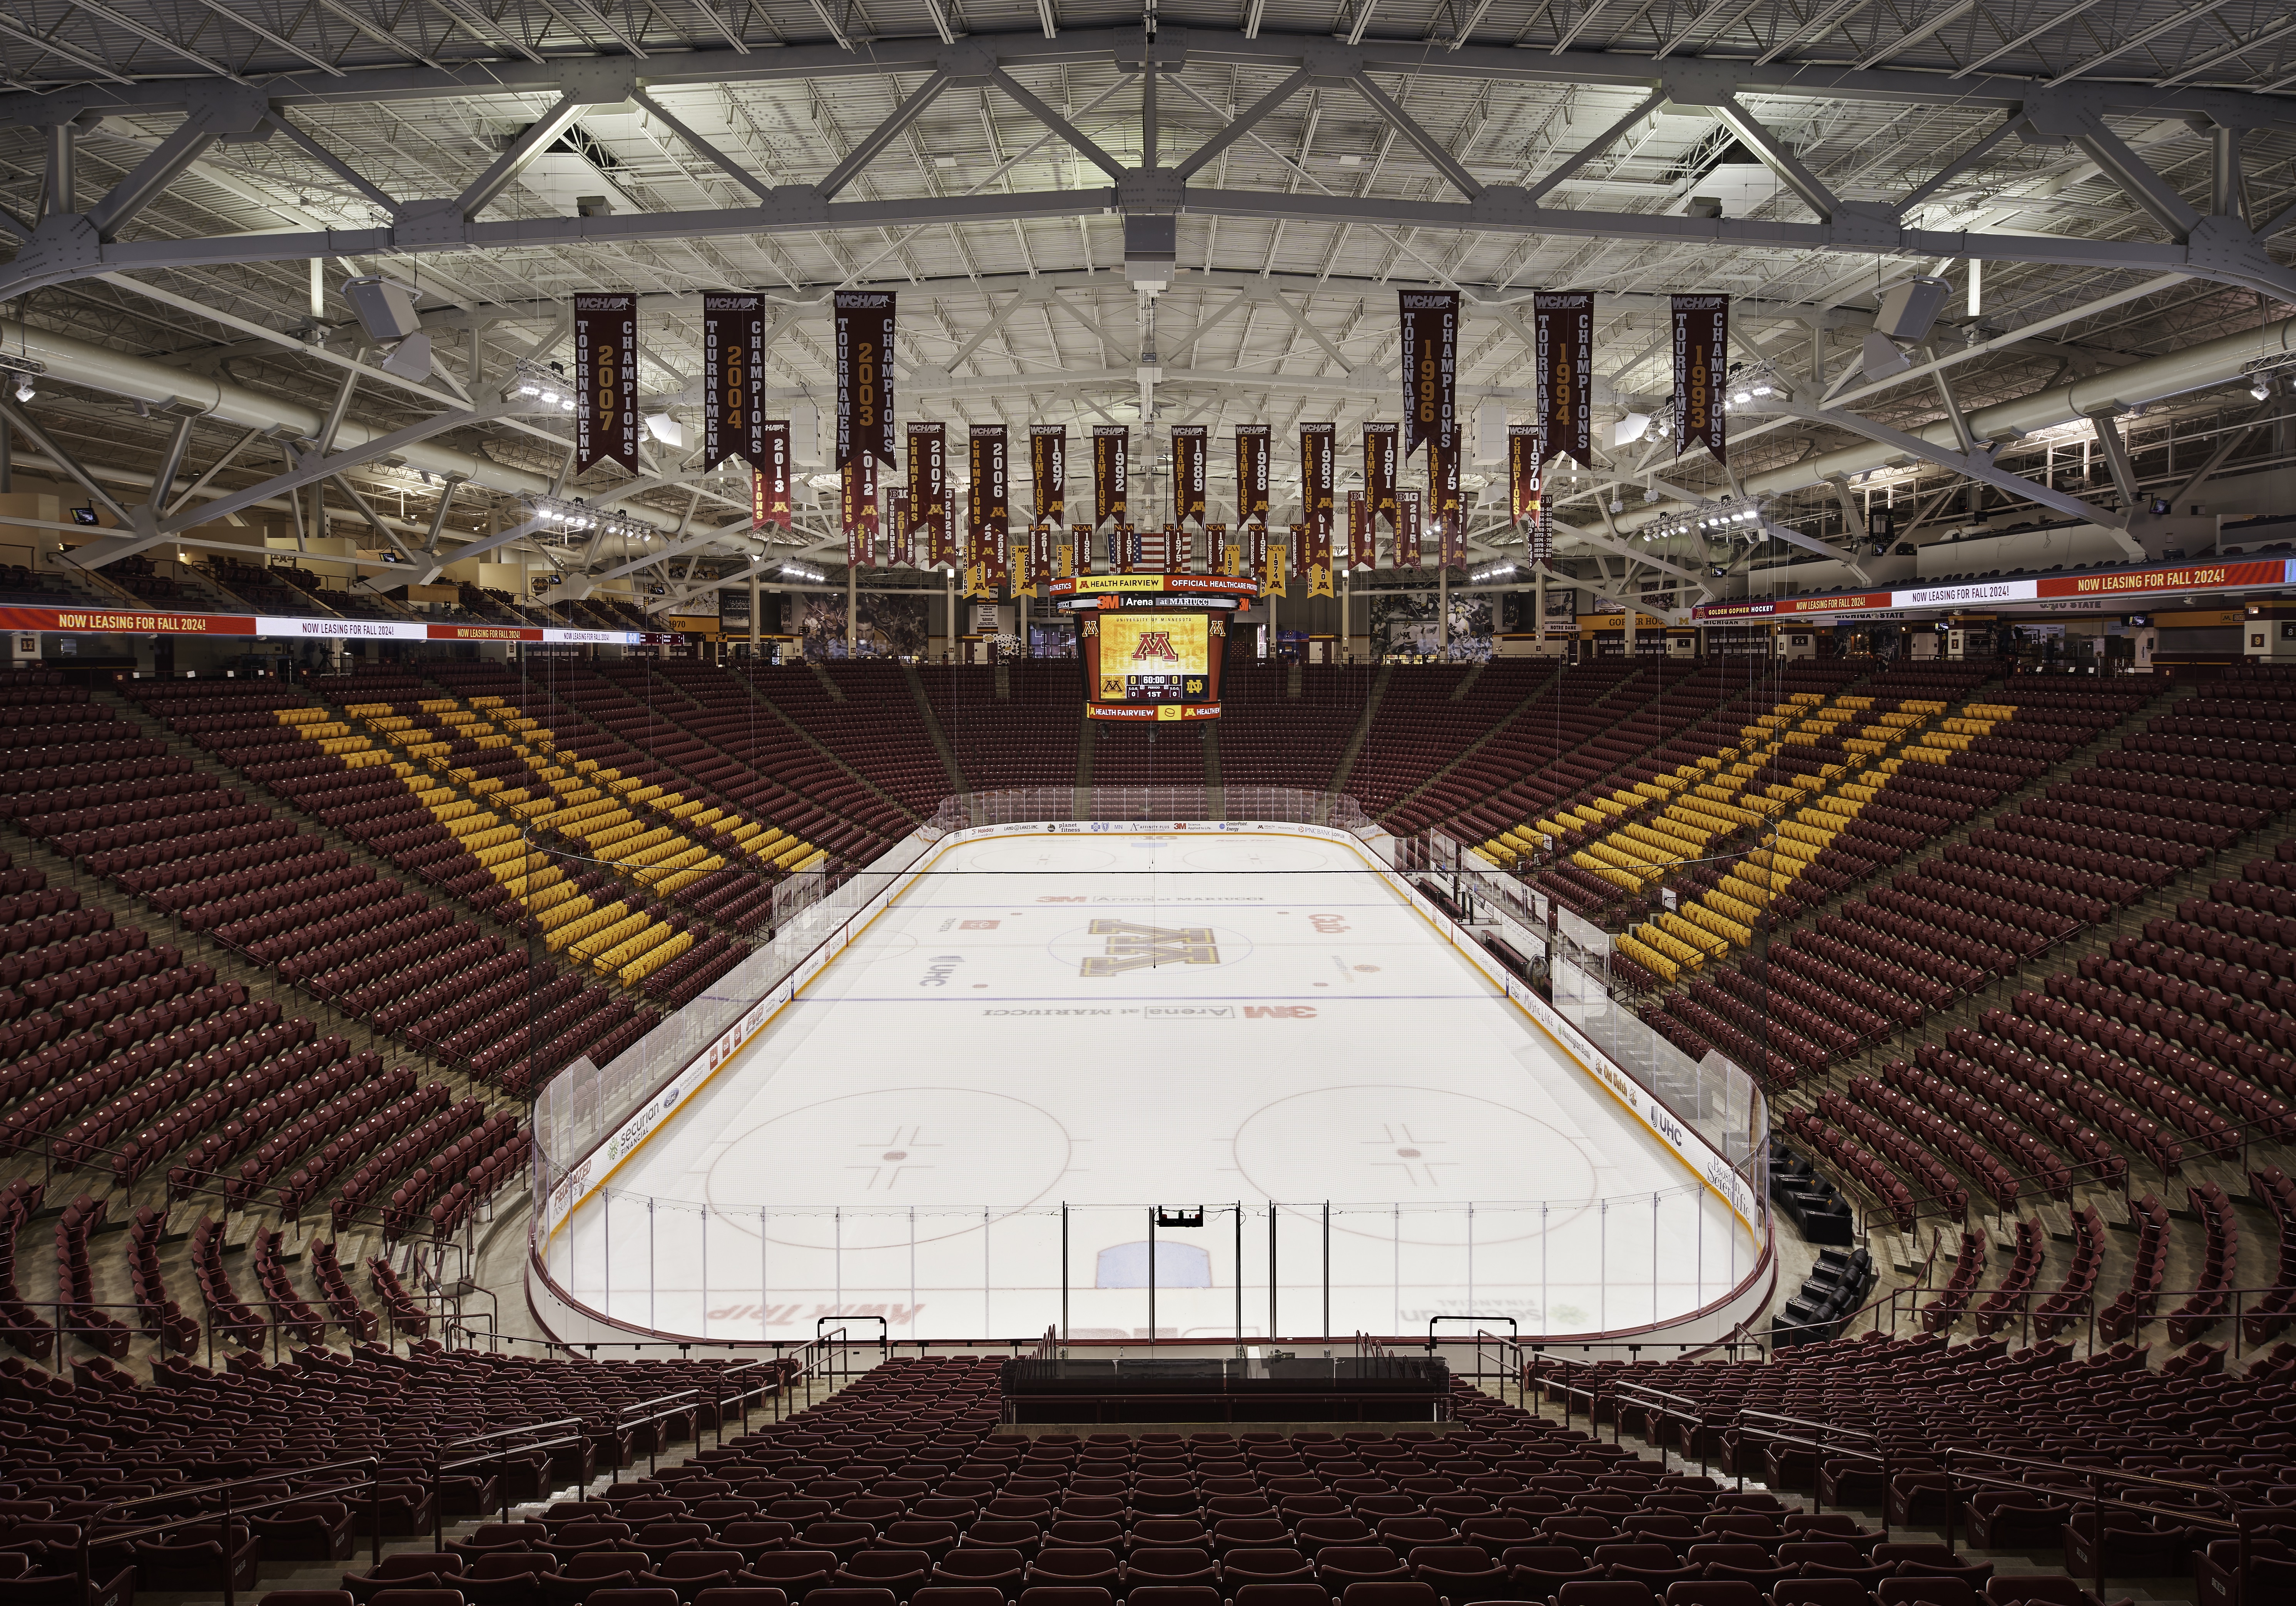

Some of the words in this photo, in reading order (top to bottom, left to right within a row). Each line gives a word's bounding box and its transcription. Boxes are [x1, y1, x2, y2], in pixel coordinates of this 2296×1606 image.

[577, 298, 621, 308] WCHA
[707, 298, 750, 308] WCHA
[836, 295, 879, 306] WCHA
[1404, 296, 1444, 307] WCHA
[1536, 296, 1579, 307] WCHA
[1672, 298, 1715, 308] WCHA
[578, 321, 590, 461] TOURNAMENT
[598, 345, 613, 430] 2007
[622, 321, 634, 455] CHAMPIONS
[707, 321, 719, 459] TOURNAMENT
[728, 346, 742, 428] 2004
[750, 321, 762, 453] CHAMPIONS
[838, 318, 850, 457] TOURNAMENT
[859, 343, 873, 426] 2003
[882, 319, 894, 452] CHAMPIONS
[1404, 313, 1415, 452] TOURNAMENT
[1421, 340, 1435, 422] 1996
[1441, 314, 1453, 447] CHAMPIONS
[1538, 315, 1549, 453] TOURNAMENT
[1556, 343, 1570, 425] 1994
[1577, 315, 1589, 448] CHAMPIONS
[1675, 313, 1687, 452] TOURNAMENT
[1691, 345, 1706, 428] 1993
[1711, 313, 1723, 447] CHAMPIONS
[774, 438, 784, 492] 2013
[931, 440, 940, 495] 2007
[973, 440, 981, 524] CHAMPIONS
[993, 443, 1003, 497] 2006
[1035, 437, 1043, 515] CHAMPIONS
[1053, 439, 1062, 491] 1997
[1115, 440, 1125, 492] 1992
[1176, 438, 1185, 515] CHAMPIONS
[1194, 440, 1203, 491] 1989
[1257, 439, 1266, 490] 1988
[1305, 435, 1313, 513] CHAMPIONS
[1322, 437, 1331, 489] 1983
[1367, 435, 1375, 512] CHAMPIONS
[1384, 437, 1394, 488] 1981
[1513, 437, 1521, 515] CHAMPIONS
[1530, 439, 1539, 491] 1970
[1031, 567, 1035, 577] UP
[1052, 583, 1071, 591] ATHLETICS
[1210, 581, 1246, 589] HEALTHCARE
[1293, 568, 1297, 577] UP
[1912, 592, 1927, 602] NOW
[1929, 590, 1955, 601] LEASING
[1957, 589, 1970, 599] FOR
[1972, 587, 1987, 598] FALL
[1990, 586, 2009, 597] 2024!
[2078, 578, 2099, 591] NOW
[2102, 575, 2142, 590] LEASING
[2145, 574, 2164, 587] FOR
[2167, 572, 2191, 585] FALL
[2194, 569, 2224, 583] 2024!
[59, 614, 87, 627] NOW
[90, 616, 134, 629] LEASING
[136, 617, 155, 629] FOR
[158, 617, 179, 630] FALL
[182, 619, 206, 631] 2024!
[1097, 595, 1119, 609] 3M
[1126, 597, 1153, 606] Arena
[22, 641, 33, 649] 17
[1131, 676, 1136, 684] 0
[1172, 676, 1178, 684] 0
[746, 1004, 764, 1031] FVP
[1150, 1007, 1228, 1018] Arena
[1243, 1006, 1317, 1019] 3M
[1562, 1027, 1581, 1051] Huntington
[1581, 1044, 1591, 1060] Bank
[1604, 1064, 1612, 1083] Old
[1614, 1073, 1627, 1097] Dutch
[621, 1102, 658, 1146] securian
[621, 1126, 649, 1156] FINANCIAL
[1660, 1113, 1682, 1146] UHC
